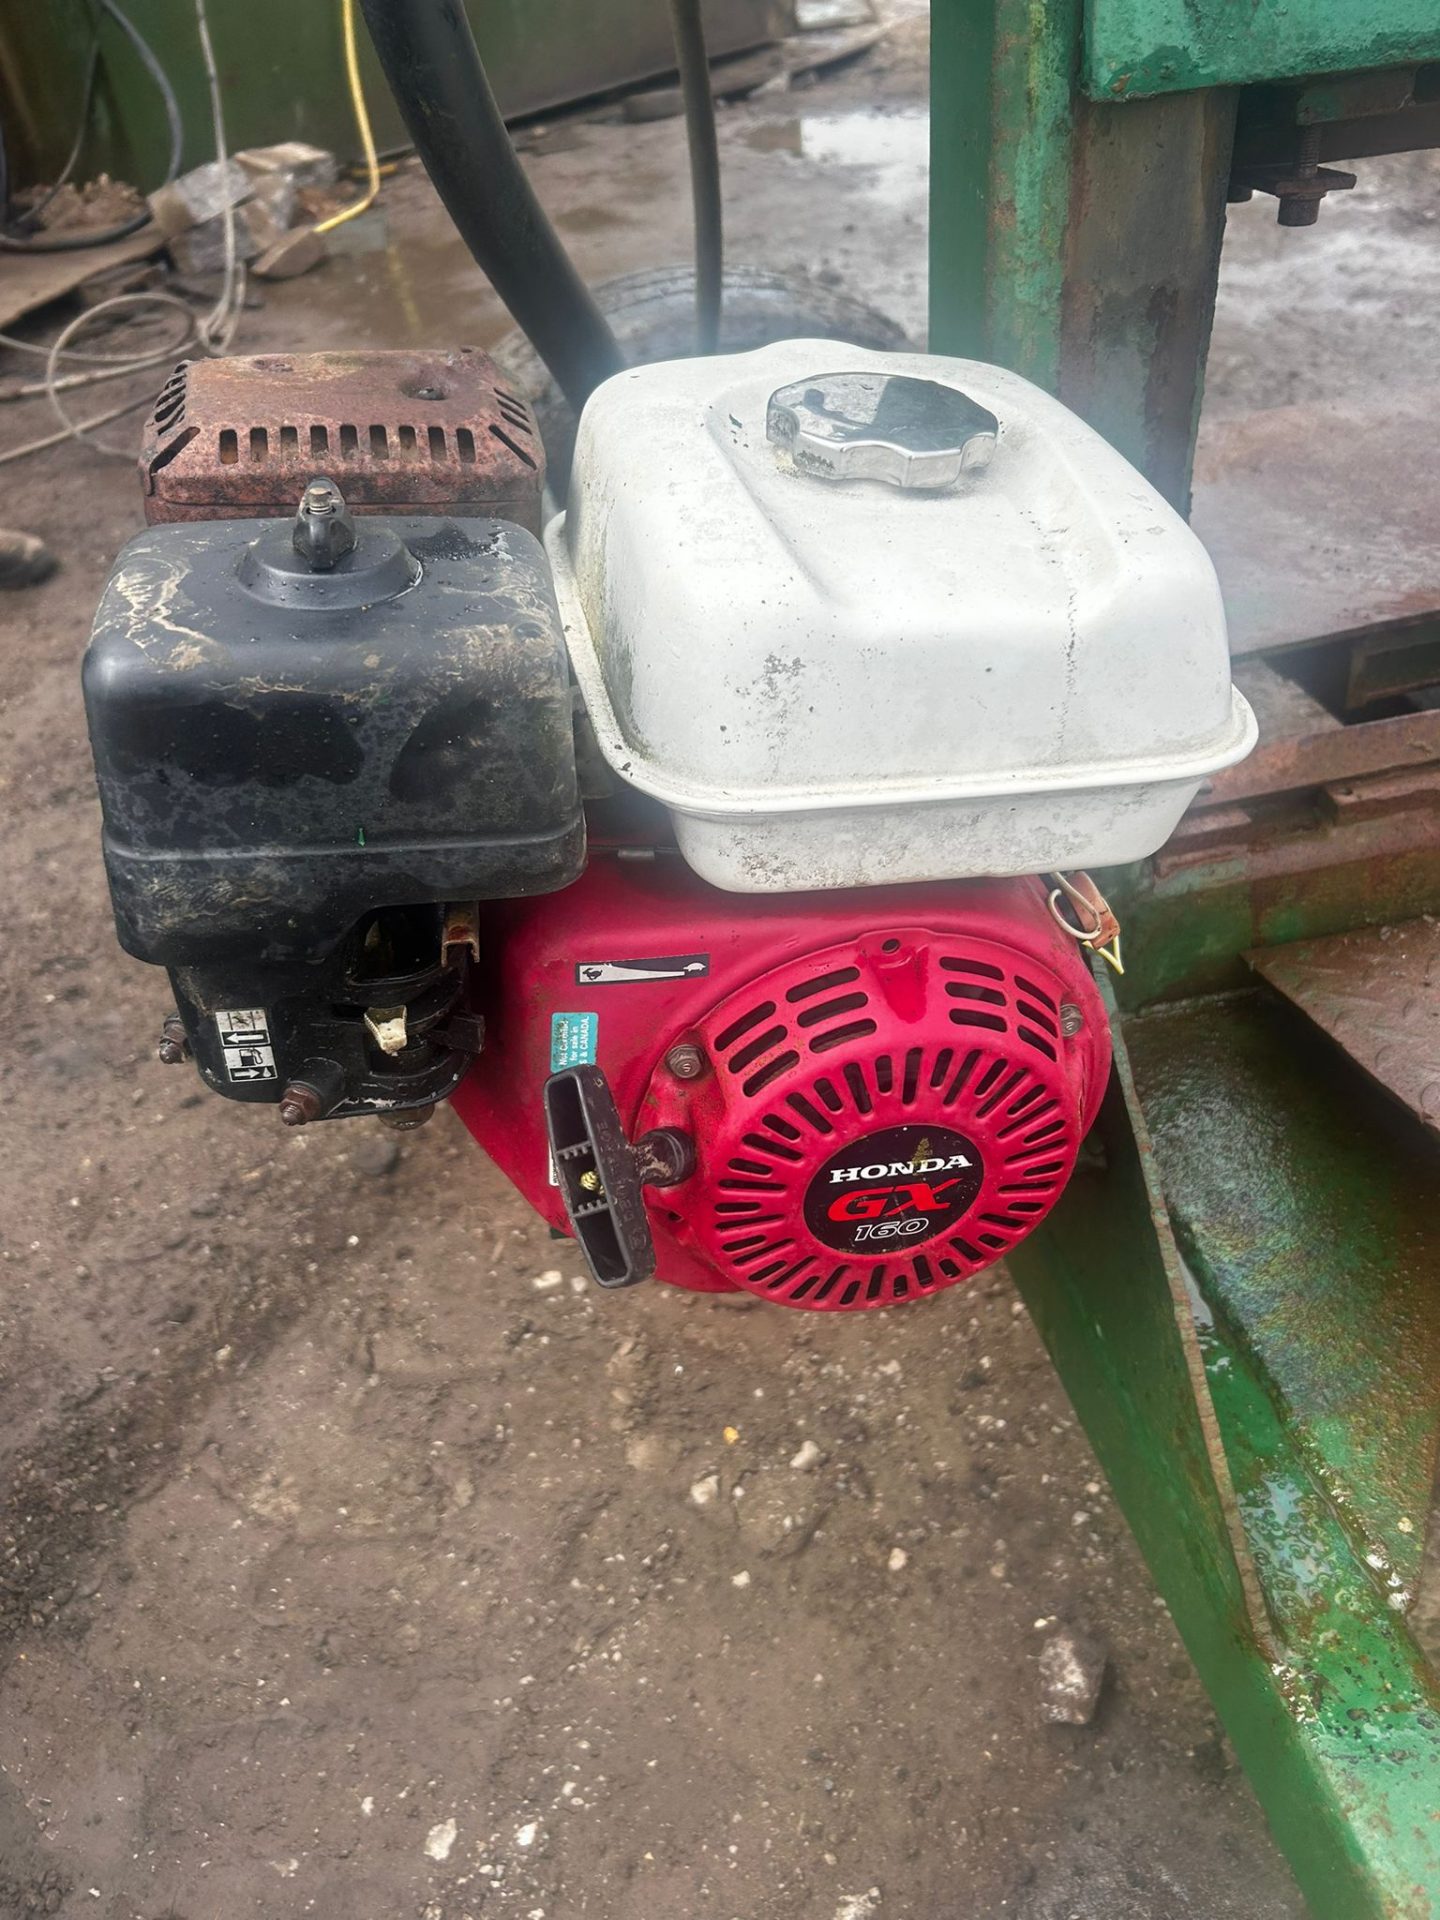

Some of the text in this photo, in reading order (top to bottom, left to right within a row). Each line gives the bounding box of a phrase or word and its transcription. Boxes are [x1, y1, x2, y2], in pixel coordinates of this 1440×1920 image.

[571, 1035, 579, 1049] sale
[559, 1052, 568, 1066] Not
[829, 1154, 973, 1183] HONDA
[827, 1178, 963, 1222] GX
[854, 1217, 929, 1241] 160
